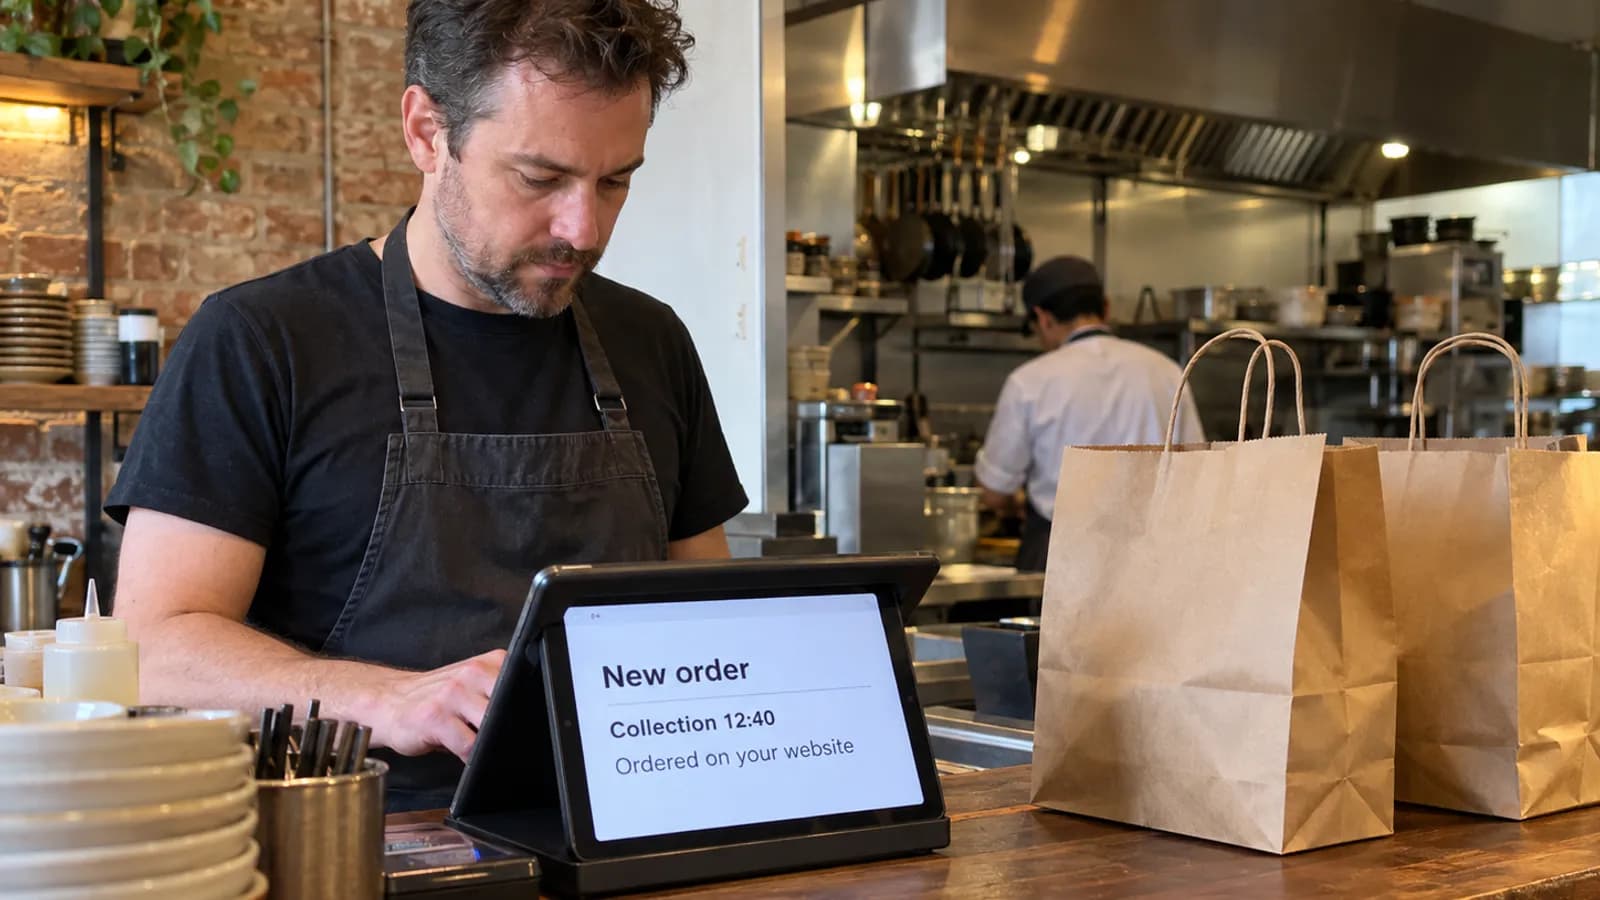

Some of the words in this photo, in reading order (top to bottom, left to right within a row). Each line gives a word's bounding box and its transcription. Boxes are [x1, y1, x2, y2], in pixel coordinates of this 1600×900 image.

[602, 664, 666, 688] New
[676, 658, 750, 684] order
[610, 715, 717, 738] Collection
[723, 710, 776, 730] 12:40
[615, 751, 699, 775] Ordered
[705, 752, 730, 767] on
[735, 748, 778, 768] your
[783, 738, 855, 759] website
